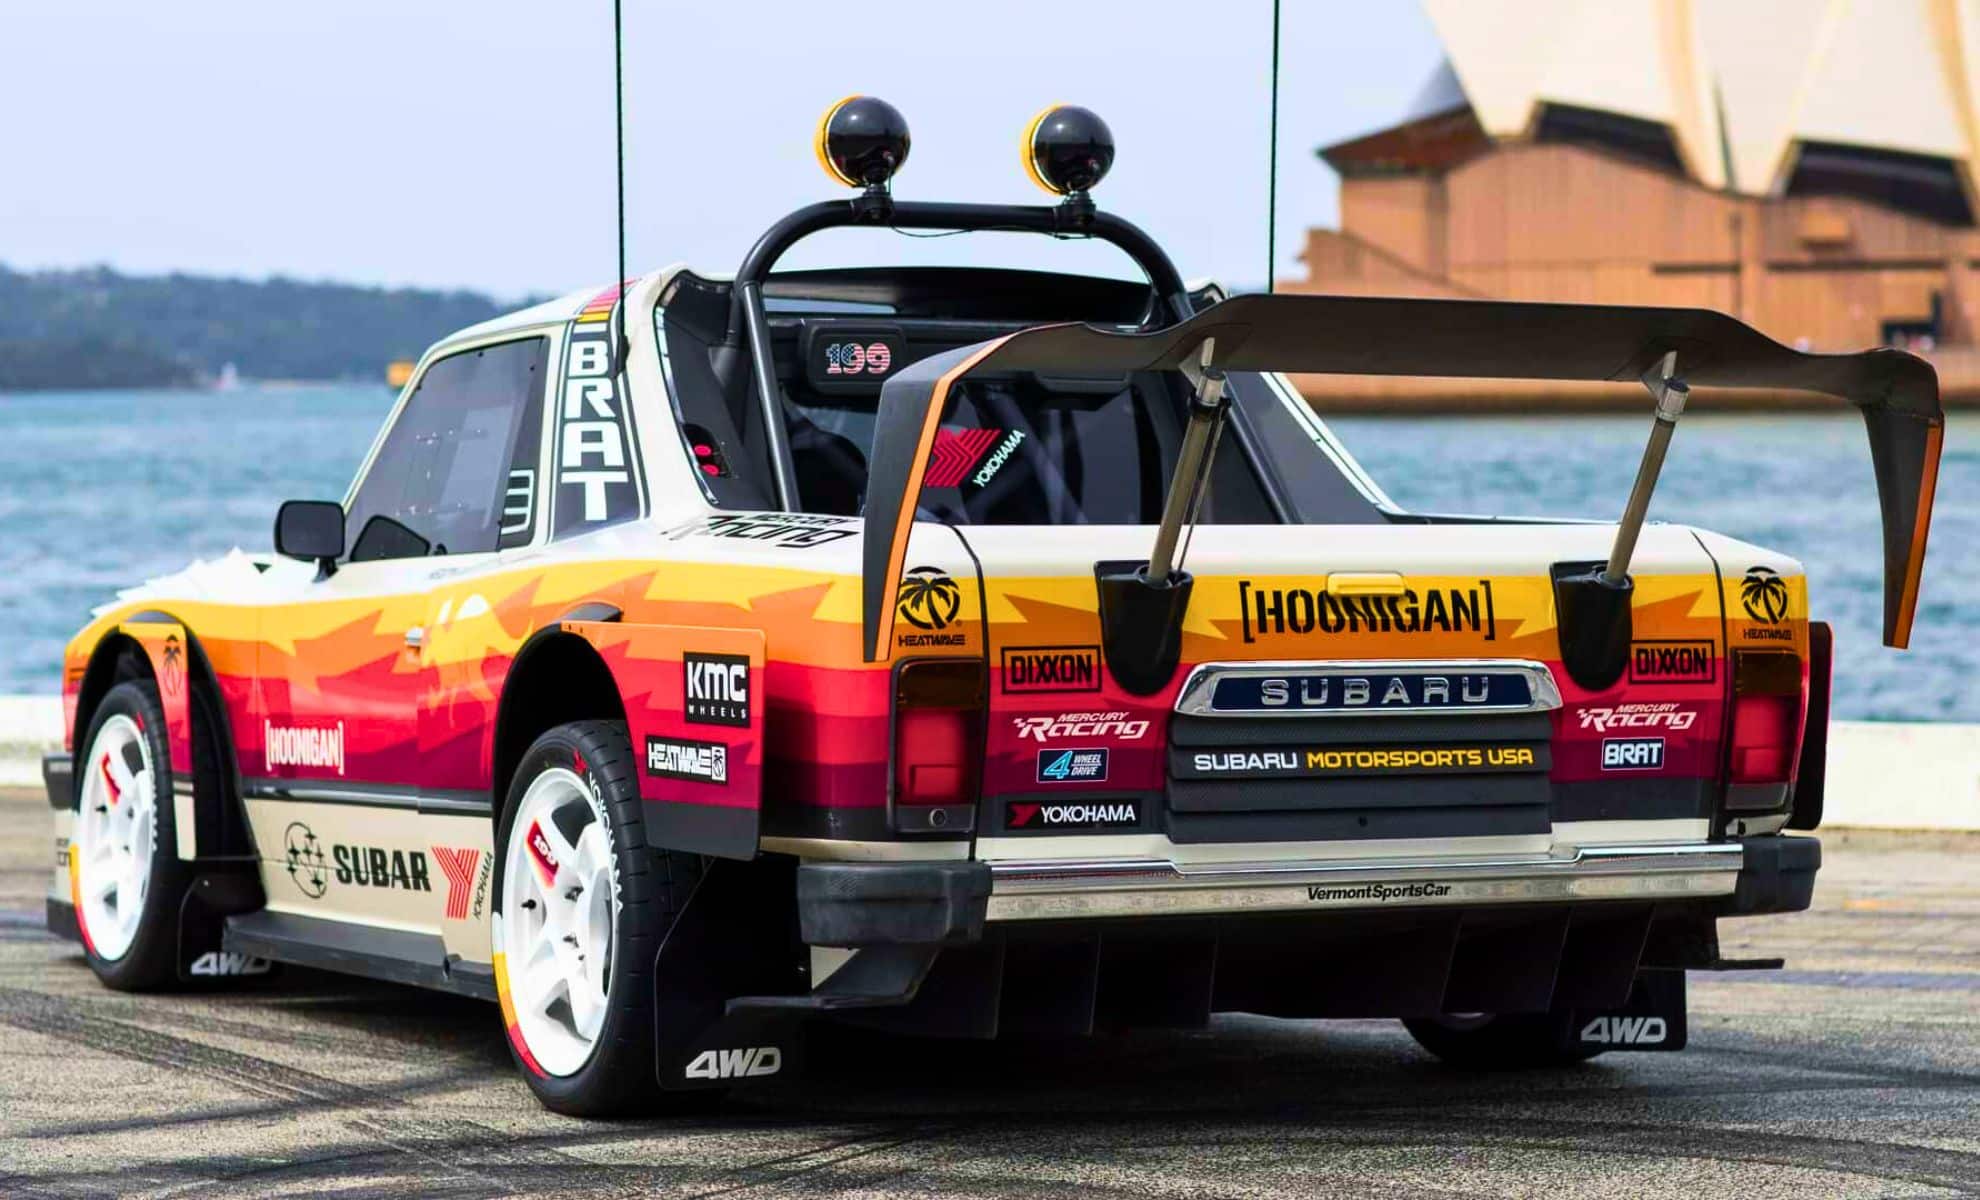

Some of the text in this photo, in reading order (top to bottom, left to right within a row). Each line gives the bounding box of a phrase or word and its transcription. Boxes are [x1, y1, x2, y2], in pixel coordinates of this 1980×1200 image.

[825, 342, 892, 375] 199
[561, 340, 629, 521] BRAT
[972, 429, 1026, 488] YOKOHAMA
[898, 634, 966, 647] HEATWAVE
[1743, 628, 1793, 641] HEATWAVE
[1010, 654, 1093, 685] DIXXON
[1635, 647, 1707, 676] DIXXON
[687, 661, 746, 702] KMC
[1260, 675, 1490, 706] SUBARU
[688, 704, 747, 719] WHEELS
[1056, 711, 1130, 723] MERCURY
[1577, 708, 1697, 732] Racing
[1616, 703, 1680, 713] MERCURY
[1013, 716, 1151, 742] Racing
[647, 741, 712, 776] HEATWAVE
[1043, 750, 1074, 779] 4
[1073, 753, 1102, 765] WHEEL
[1194, 748, 1534, 771] SUBARU MOTORSPORTS USA
[1603, 742, 1663, 766] BRAT
[1071, 766, 1099, 776] DRIVE
[1041, 803, 1137, 824] YOKOHAMA
[1307, 882, 1452, 901] VermontSportsCar
[1580, 1016, 1667, 1043] 4WD
[685, 1046, 782, 1079] 4WD
